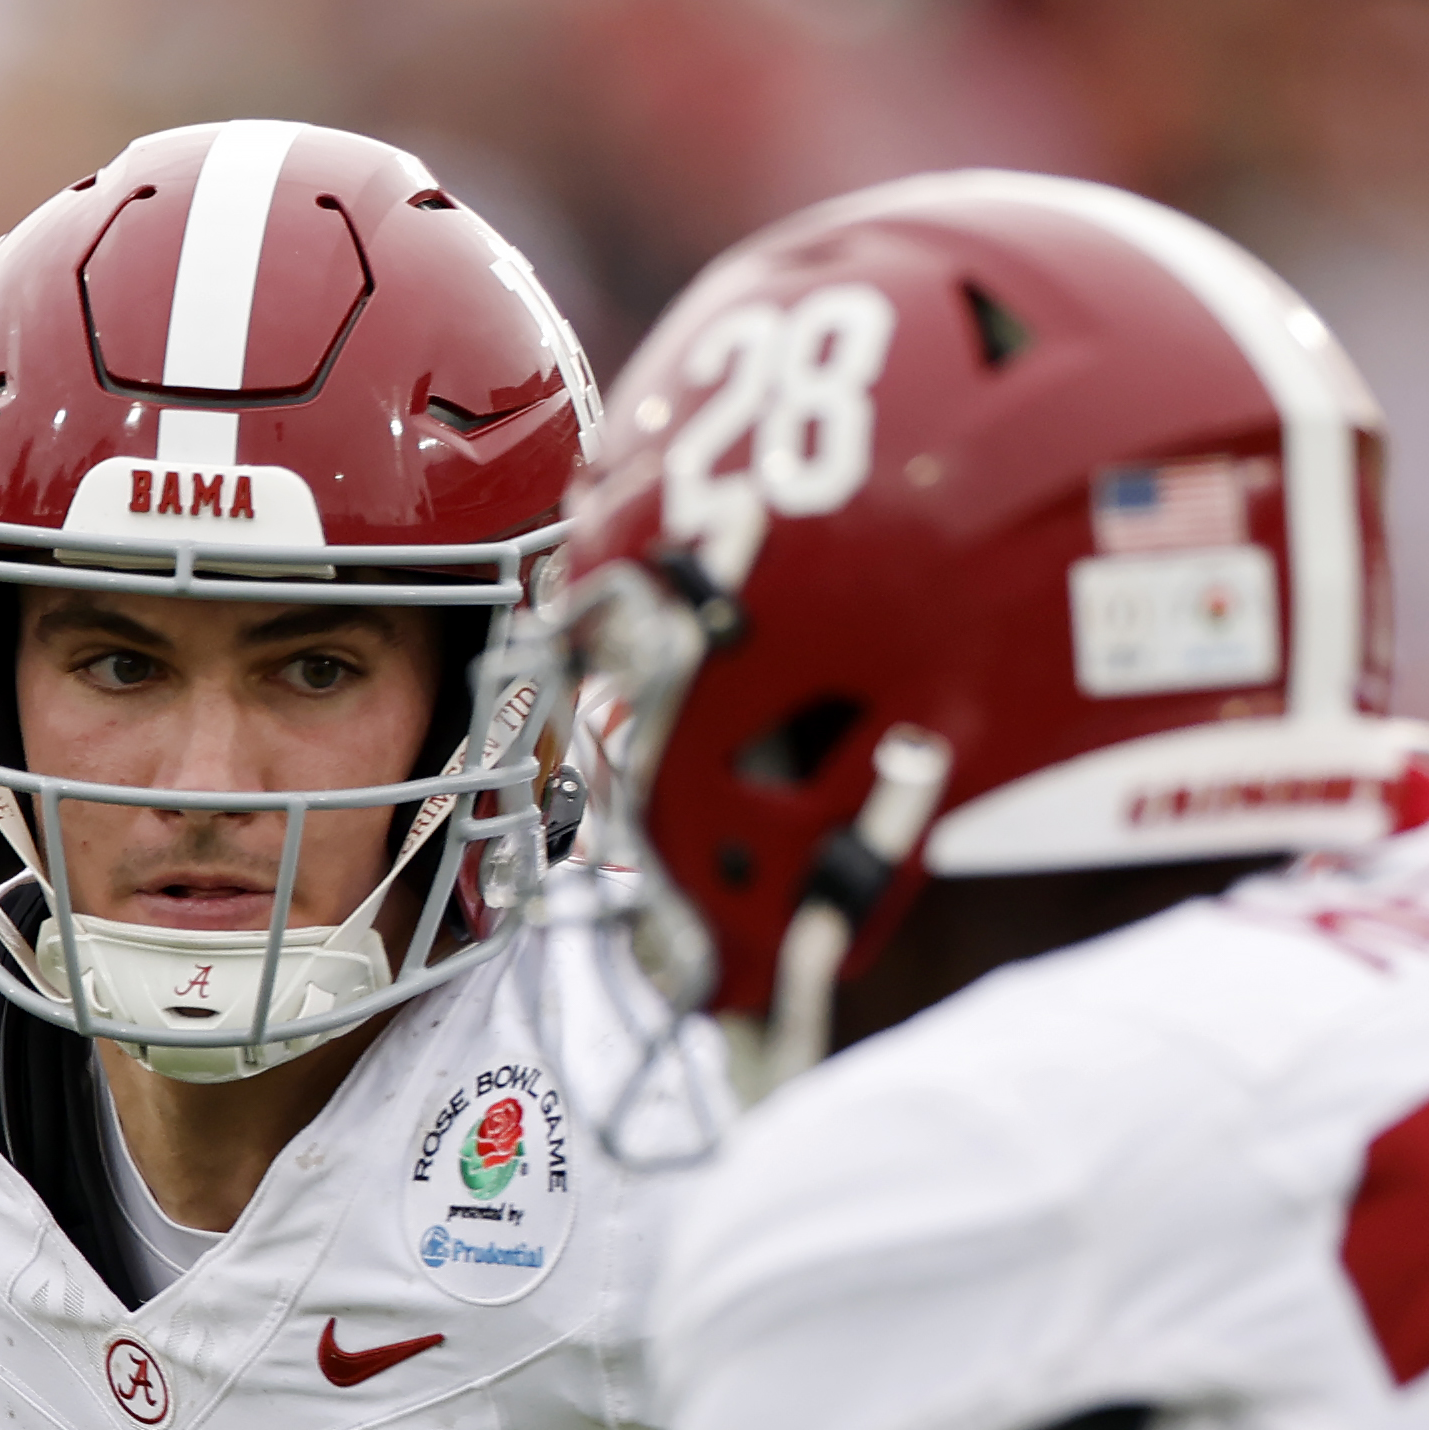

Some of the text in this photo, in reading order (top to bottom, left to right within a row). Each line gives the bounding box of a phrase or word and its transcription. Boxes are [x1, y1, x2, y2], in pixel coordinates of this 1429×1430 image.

[664, 282, 898, 540] 28
[129, 469, 255, 519] BAMA
[494, 678, 540, 732] TID
[174, 963, 213, 998] A
[413, 1064, 567, 1192] ROSE BOWL GAME
[452, 1239, 544, 1268] Prudential
[117, 1352, 157, 1407] A
